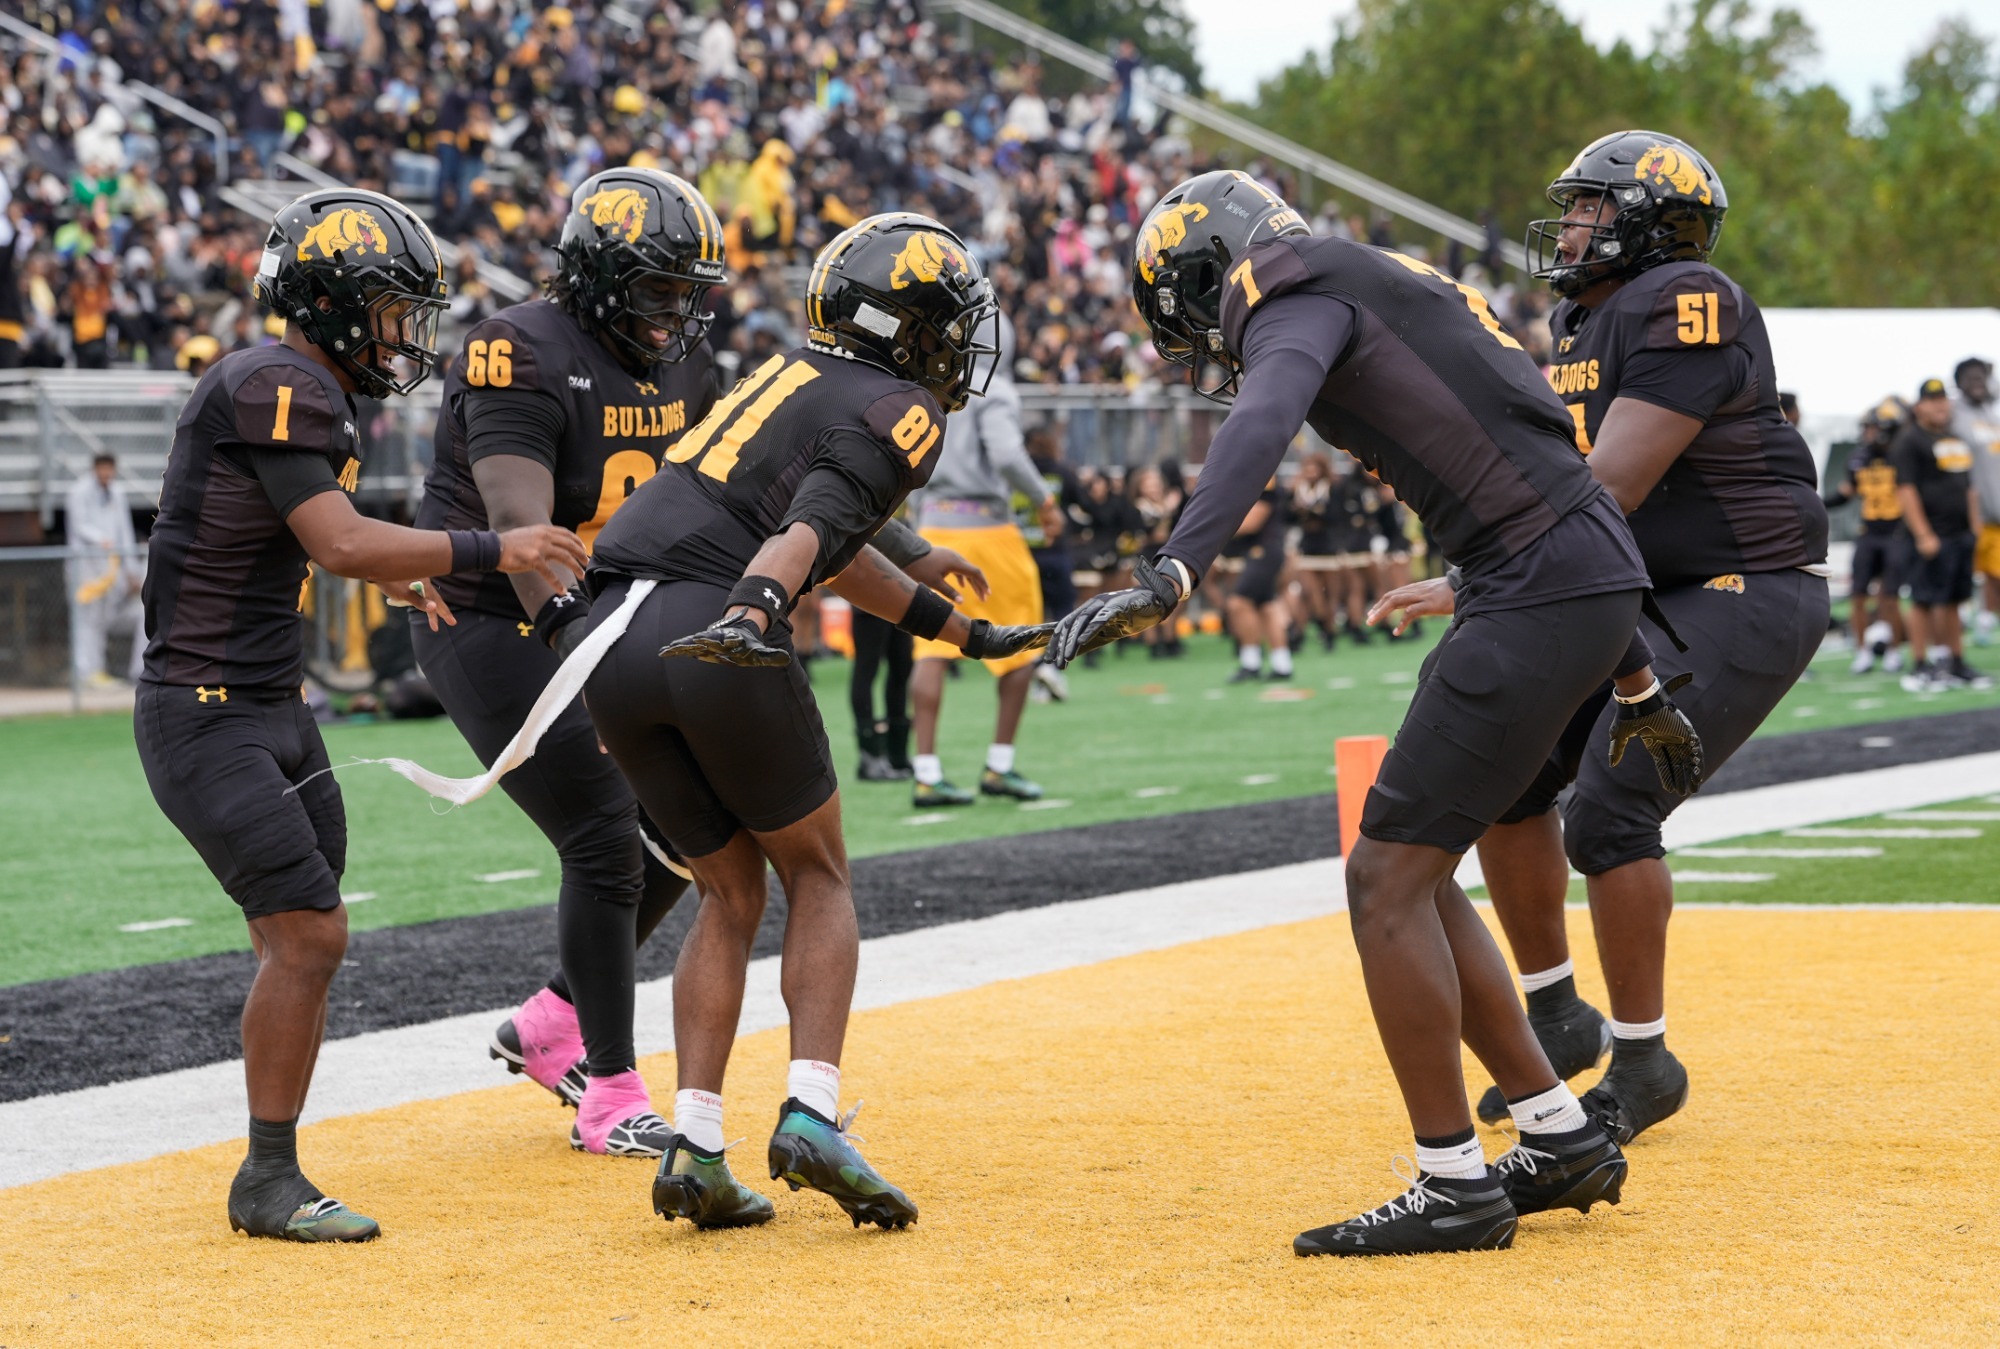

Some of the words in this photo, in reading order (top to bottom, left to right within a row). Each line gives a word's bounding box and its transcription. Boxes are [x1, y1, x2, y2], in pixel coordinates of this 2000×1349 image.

[694, 263, 722, 277] Riddell
[1230, 258, 1262, 308] 7
[1676, 292, 1720, 344] 51
[467, 339, 512, 387] 66
[272, 386, 293, 441] 1
[603, 400, 685, 437] BULLDOGS
[891, 404, 941, 469] 81
